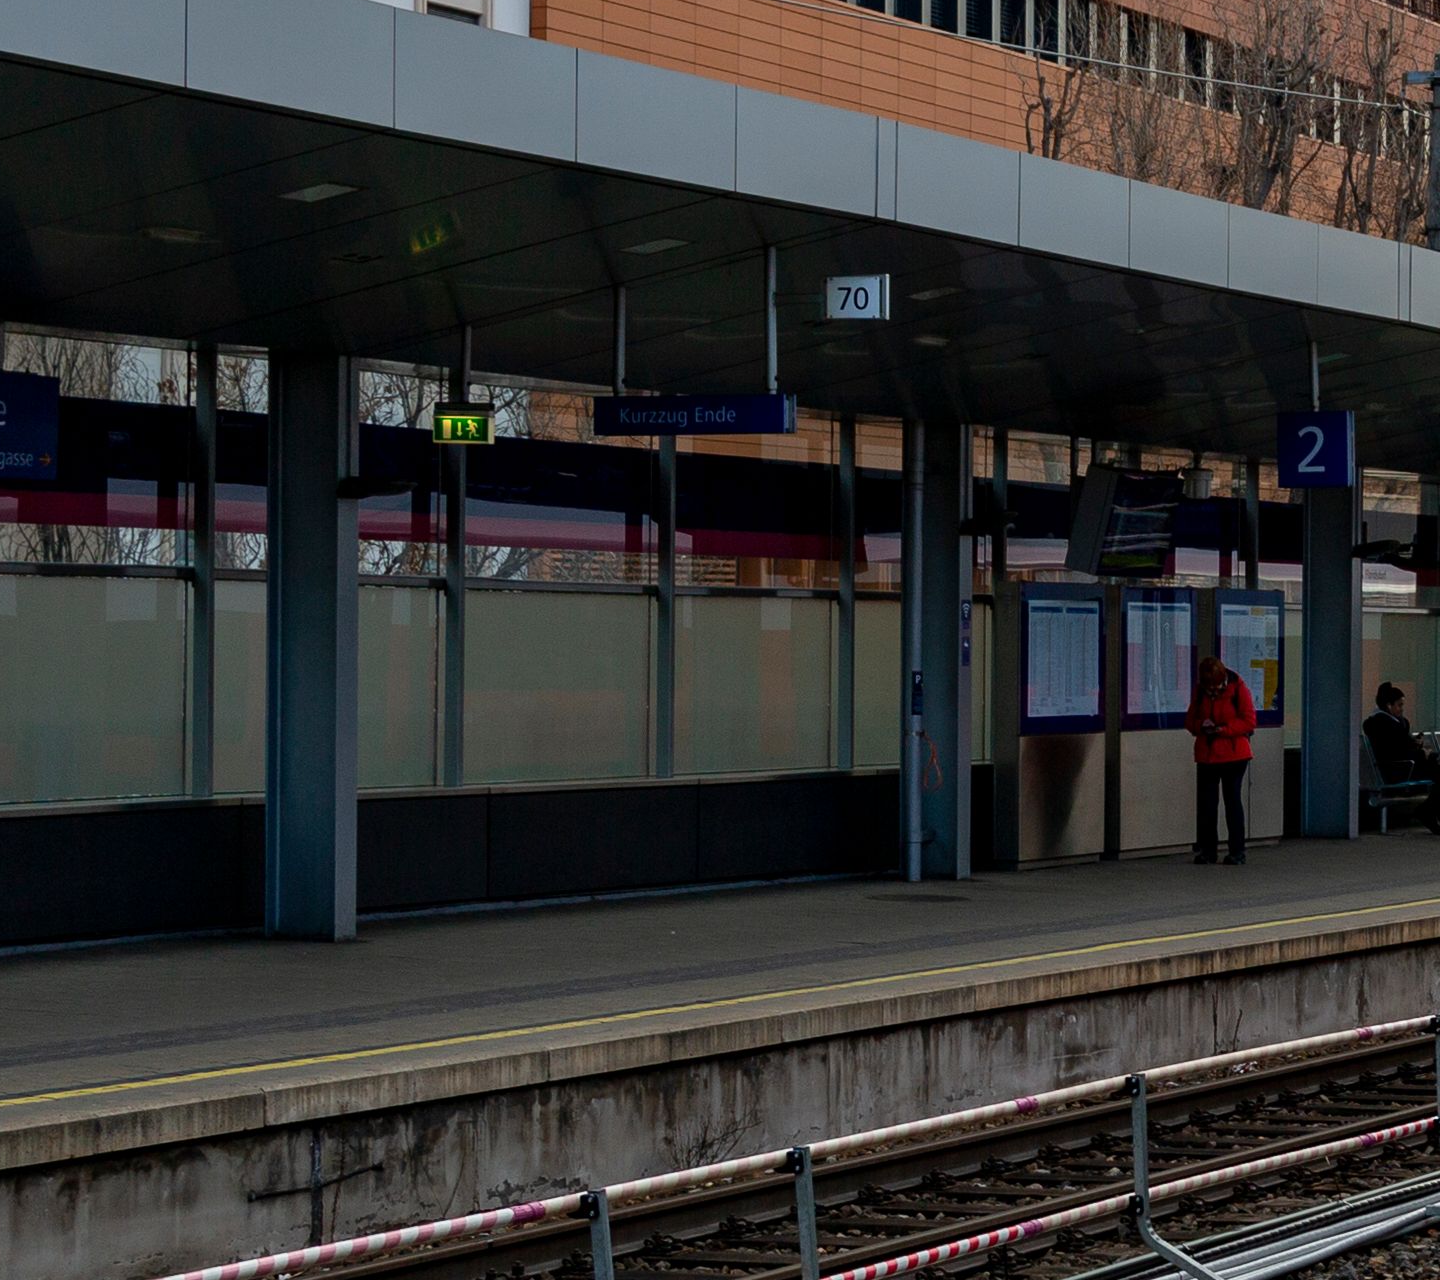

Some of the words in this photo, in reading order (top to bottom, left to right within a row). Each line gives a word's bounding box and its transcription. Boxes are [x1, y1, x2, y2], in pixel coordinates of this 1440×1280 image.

[837, 287, 869, 311] 70
[619, 407, 689, 428] Kurzzug
[695, 406, 737, 423] Ende
[1298, 426, 1326, 473] 2
